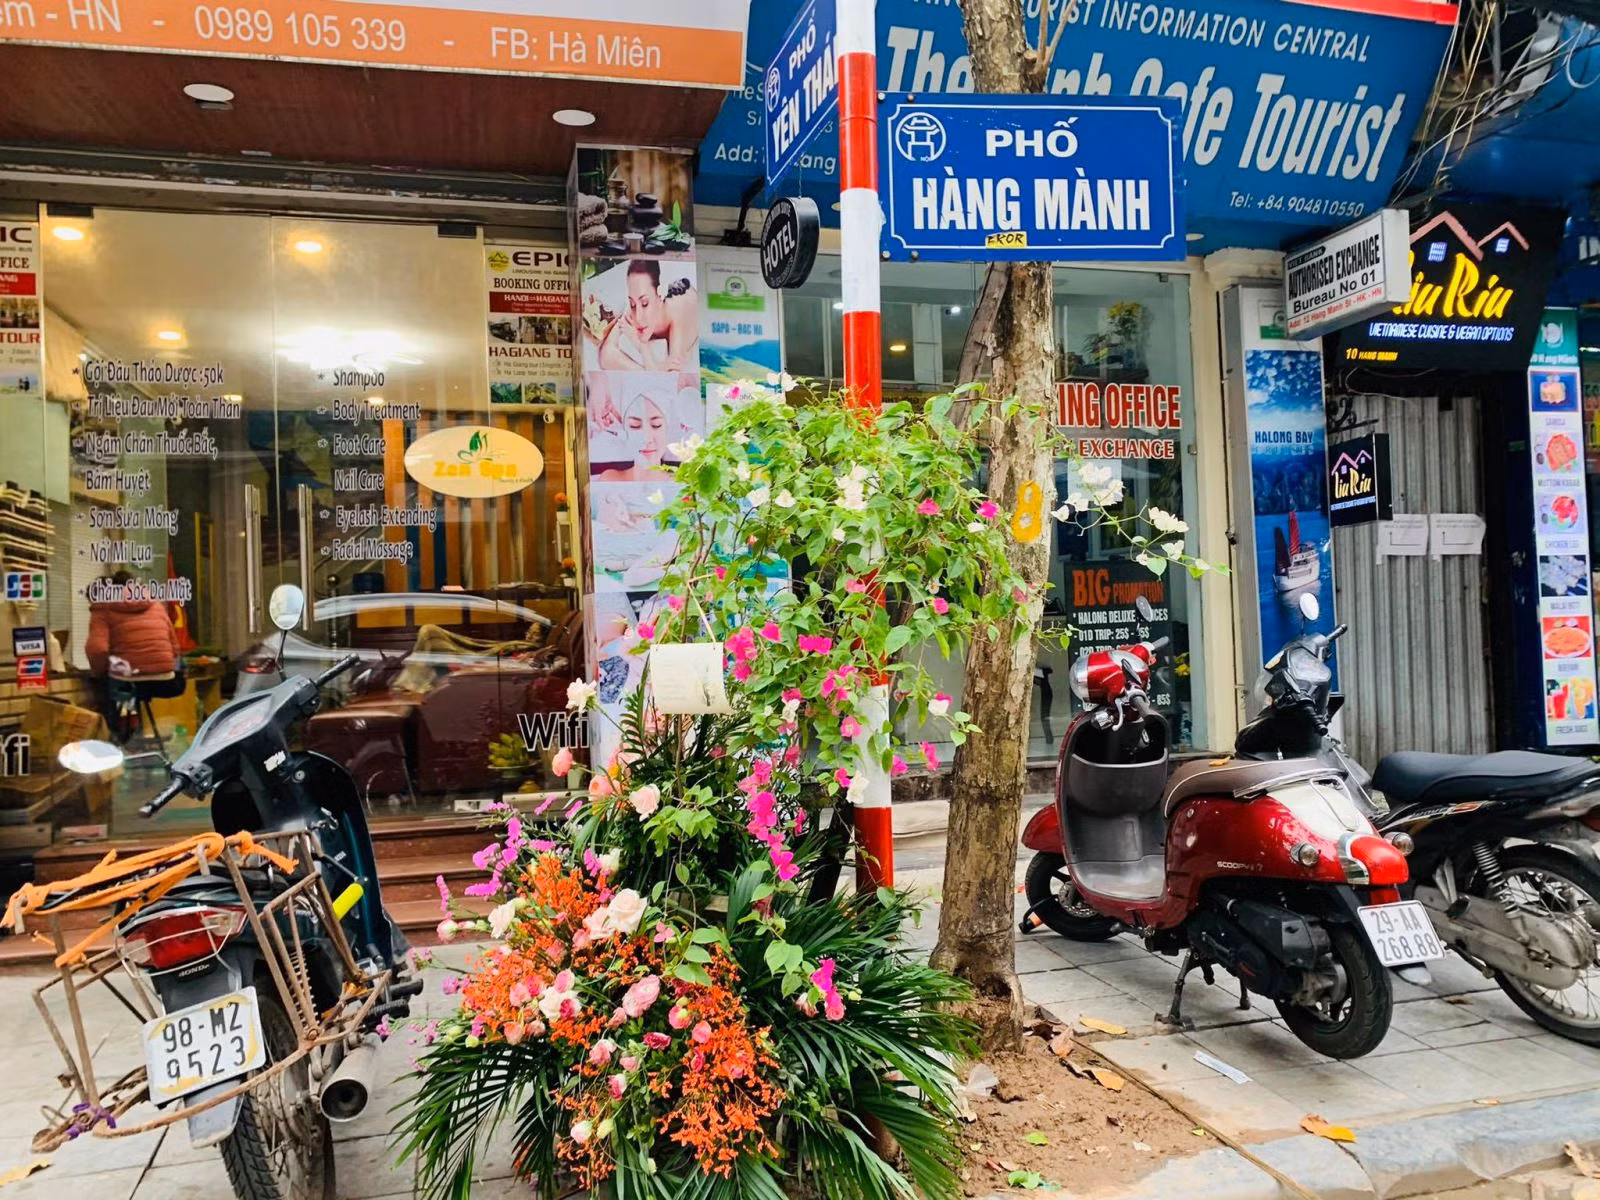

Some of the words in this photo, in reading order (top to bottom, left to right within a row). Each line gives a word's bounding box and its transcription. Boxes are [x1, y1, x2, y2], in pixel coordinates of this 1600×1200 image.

[67, 1, 122, 32] HN
[193, 5, 274, 42] 0989
[285, 12, 340, 47] 105
[351, 17, 406, 51] 339
[491, 27, 539, 60] FB:
[549, 29, 587, 64] Hà
[597, 35, 661, 68] Miên
[788, 8, 816, 80] PHỐ
[1026, 0, 1096, 27] URIST
[1100, 2, 1265, 47] INFORMATION
[1273, 23, 1371, 62] CENTRAL
[772, 90, 800, 163] YÊN
[985, 117, 1079, 157] PHỐ
[1239, 73, 1406, 182] Tourist
[714, 142, 760, 163] Add:
[794, 153, 837, 175] ang
[912, 166, 1021, 230] HÀNG
[1034, 167, 1151, 231] MÀNH
[1229, 191, 1253, 209] Tel:
[1257, 197, 1364, 218] +84.904810550
[763, 220, 796, 277] HOTEL
[1288, 254, 1335, 301] AUTHORISED
[1336, 234, 1380, 281] EXCHANGE
[493, 277, 541, 290] BOOKING
[1294, 288, 1337, 314] Bureau
[1340, 280, 1358, 305] No
[1361, 269, 1376, 286] 01
[1445, 252, 1513, 318] Riu
[1369, 322, 1419, 338] VIETNAMESE
[1418, 324, 1448, 340] CUISINE
[1455, 326, 1482, 341] VEGAN
[1480, 327, 1515, 342] OPTIONS
[489, 346, 551, 358] HAGIANG
[1346, 348, 1359, 360] 10
[165, 362, 197, 389] Dược
[333, 370, 385, 391] Shampoo
[131, 395, 156, 418] Đau
[333, 400, 362, 425] Body
[364, 400, 421, 419] Treatment
[1054, 382, 1100, 428] ING
[1105, 383, 1182, 429] OFFICE
[333, 433, 360, 455] Foot
[361, 433, 386, 455] Care
[1078, 438, 1174, 459] EXCHANGE
[1254, 431, 1292, 443] HALONG
[1295, 431, 1313, 443] BAY
[334, 467, 358, 491] Nail
[359, 469, 384, 491] Care
[335, 503, 378, 532] Eyelash
[381, 502, 437, 532] Extending
[112, 541, 128, 563] Mi
[130, 543, 153, 569] Lụa
[332, 537, 364, 560] Facial
[365, 538, 414, 565] Massage
[149, 579, 165, 601] Da
[1072, 568, 1111, 607] BIG
[1078, 611, 1107, 625] HALONG
[1108, 609, 1136, 623] DELUXE
[21, 642, 41, 651] VISA
[1095, 627, 1114, 641] TRIP:
[1115, 627, 1130, 641] 25$
[517, 712, 590, 752] Wifi
[0, 734, 31, 777] fi
[1370, 907, 1424, 935] 29-AA
[1376, 932, 1440, 962] 268.88
[163, 1001, 243, 1054] 98-M2
[167, 1036, 247, 1086] 9523
